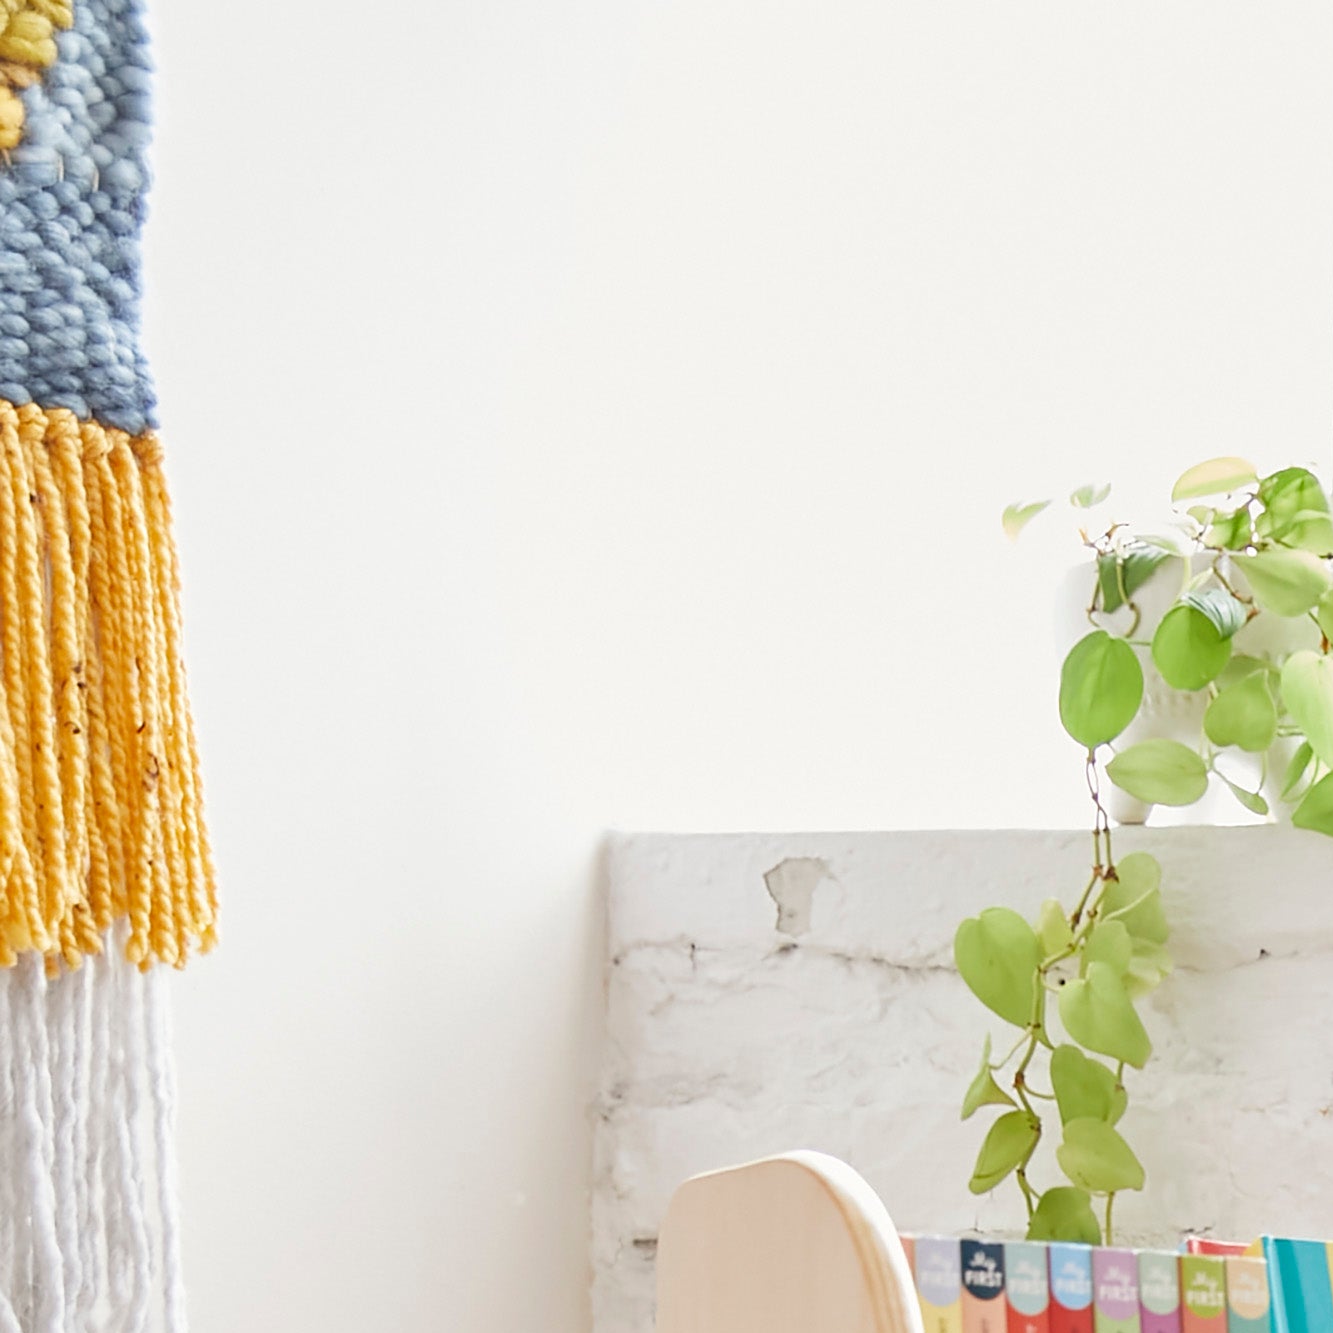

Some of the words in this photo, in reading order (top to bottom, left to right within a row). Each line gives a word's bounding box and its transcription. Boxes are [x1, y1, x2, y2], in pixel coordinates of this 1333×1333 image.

[965, 1270, 1002, 1287] FIRST
[1099, 1284, 1138, 1303] FIRST
[1187, 1290, 1225, 1307] FIRST
